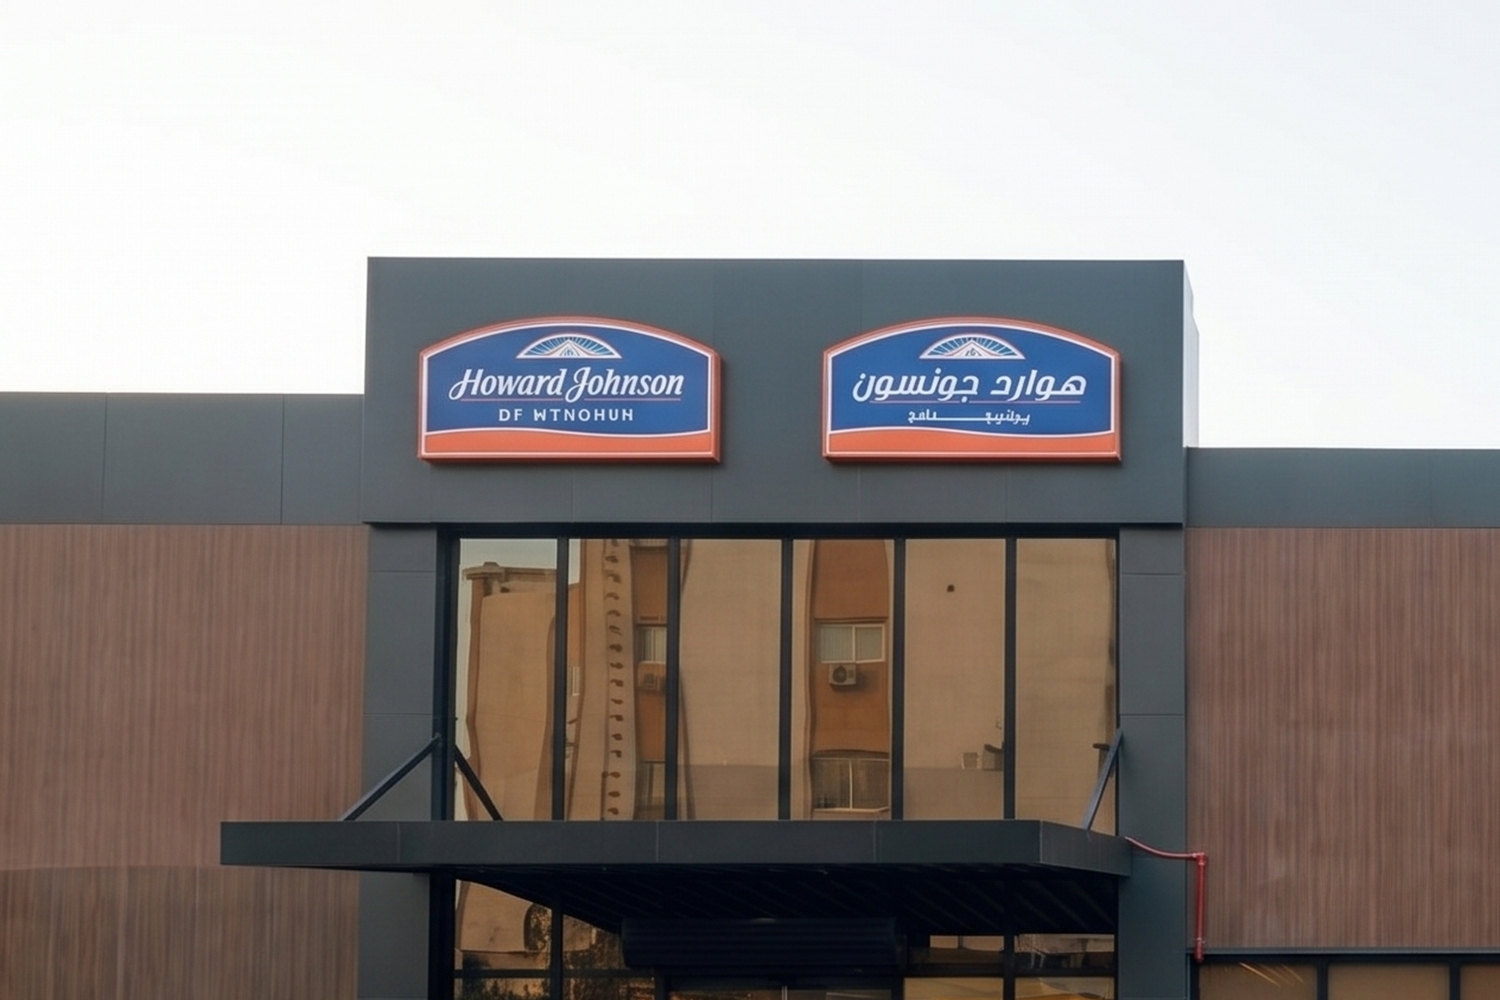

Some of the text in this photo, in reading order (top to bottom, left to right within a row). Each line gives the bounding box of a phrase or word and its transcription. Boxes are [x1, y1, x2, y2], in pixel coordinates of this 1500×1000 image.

[448, 366, 685, 403] Howard Johnson
[852, 367, 1087, 403] هوارد جونسون
[498, 408, 523, 422] DF
